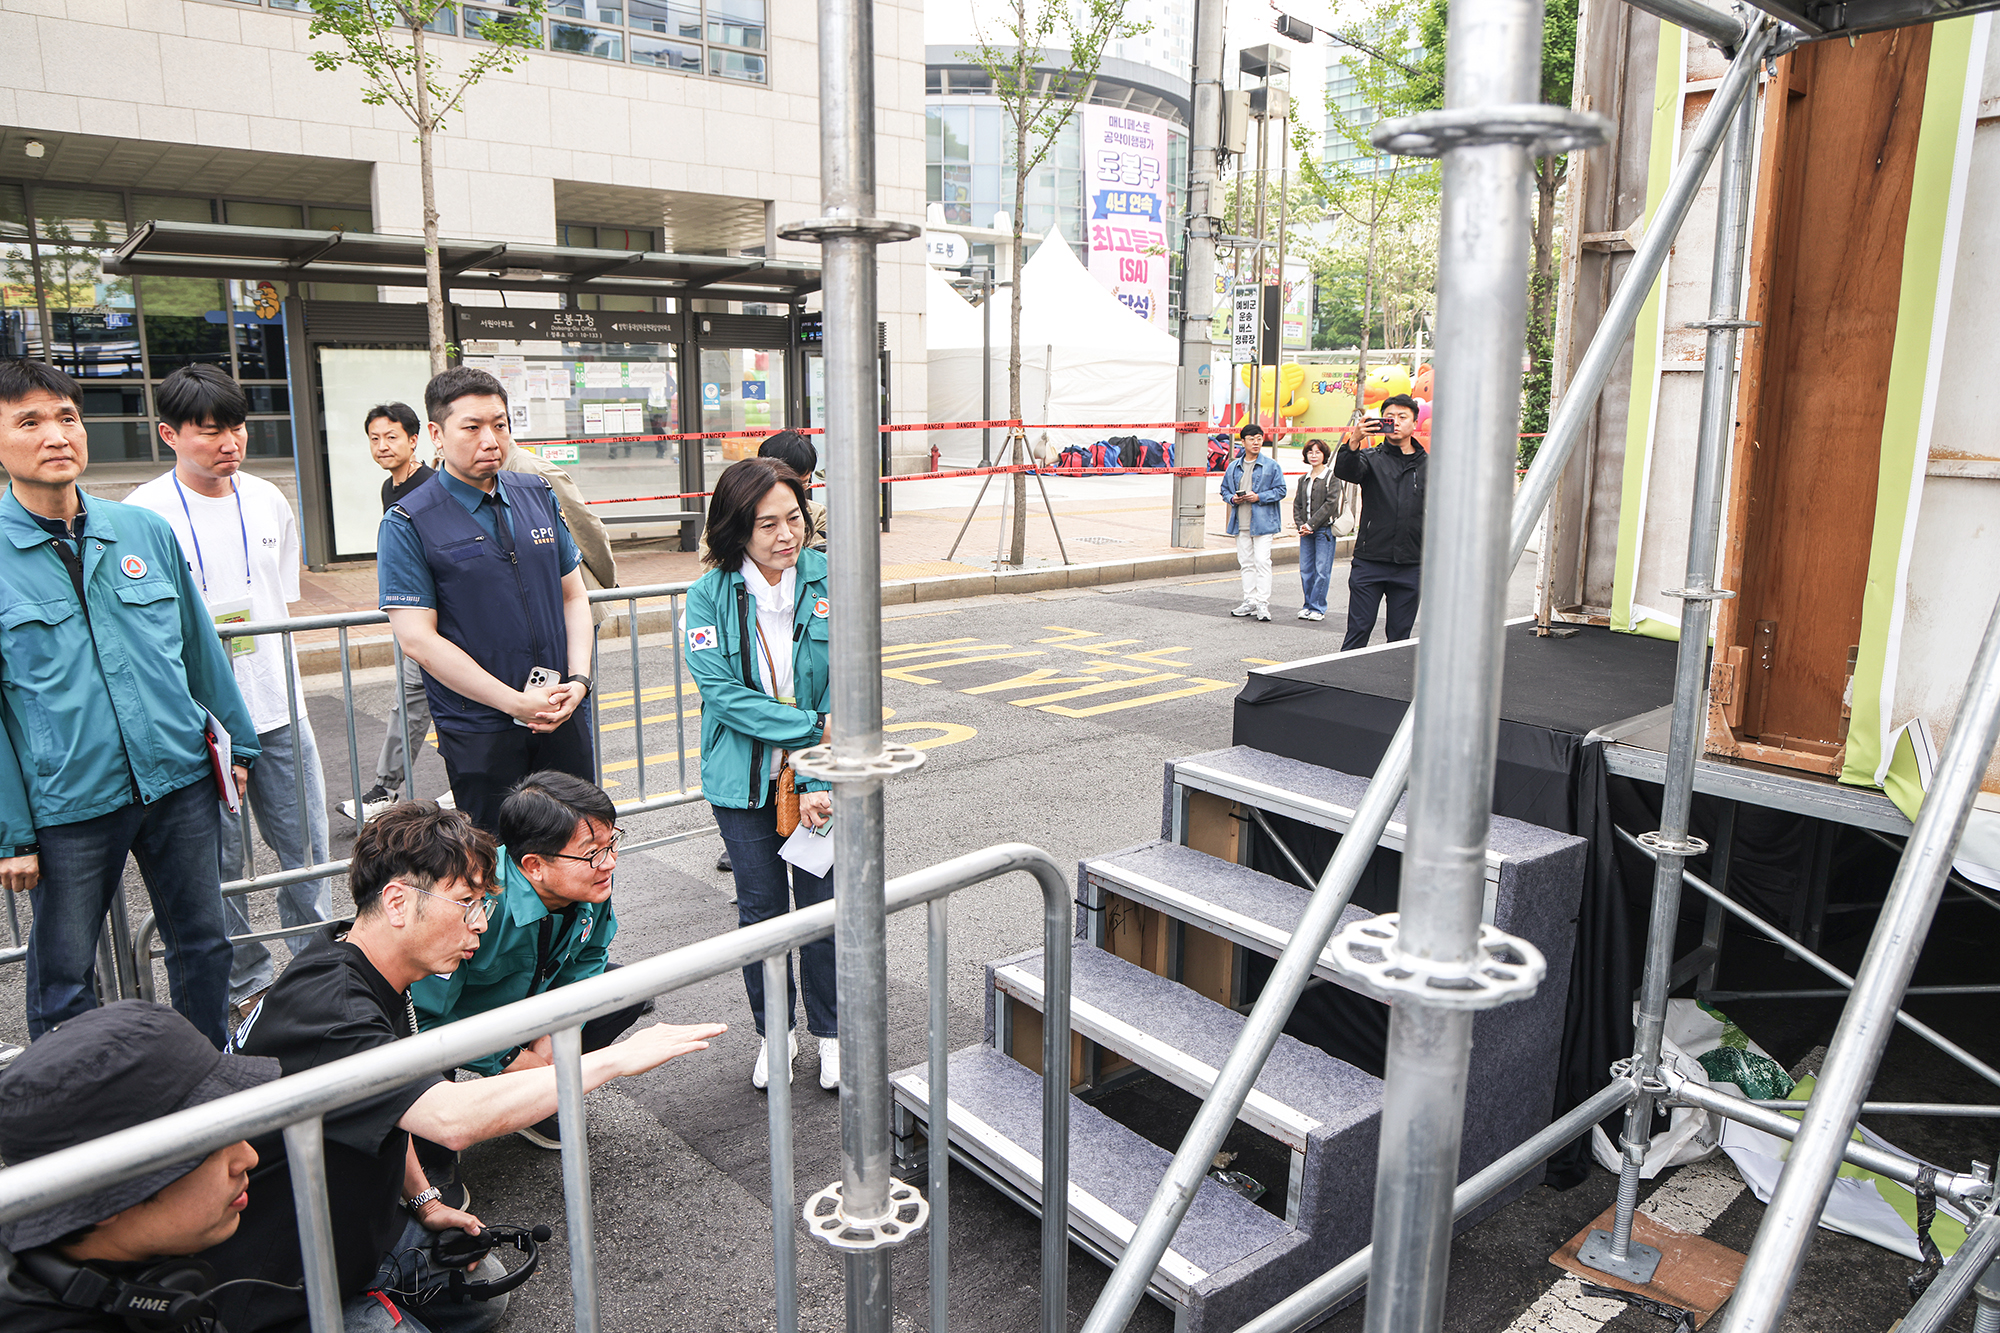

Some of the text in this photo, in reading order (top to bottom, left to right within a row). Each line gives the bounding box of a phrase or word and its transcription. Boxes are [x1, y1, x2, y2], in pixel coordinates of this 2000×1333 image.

[1108, 115, 1151, 134] 매니페스토
[1103, 130, 1154, 150] 공약이행평가
[1097, 149, 1160, 188] 도봉구
[1105, 192, 1153, 214] 4년 연속
[935, 242, 954, 258] 도봉
[1235, 299, 1256, 310] 예비군
[553, 313, 595, 327] 도봉구청
[1238, 311, 1253, 322] 운송
[480, 319, 515, 329] 서원아파트
[1238, 323, 1252, 333] 버스
[1235, 334, 1256, 345] 정류장
[575, 372, 585, 383] 08
[955, 469, 977, 477] DANGER
[987, 466, 1008, 474] DANGER
[531, 527, 554, 539] CPO
[129, 1295, 171, 1312] HME
